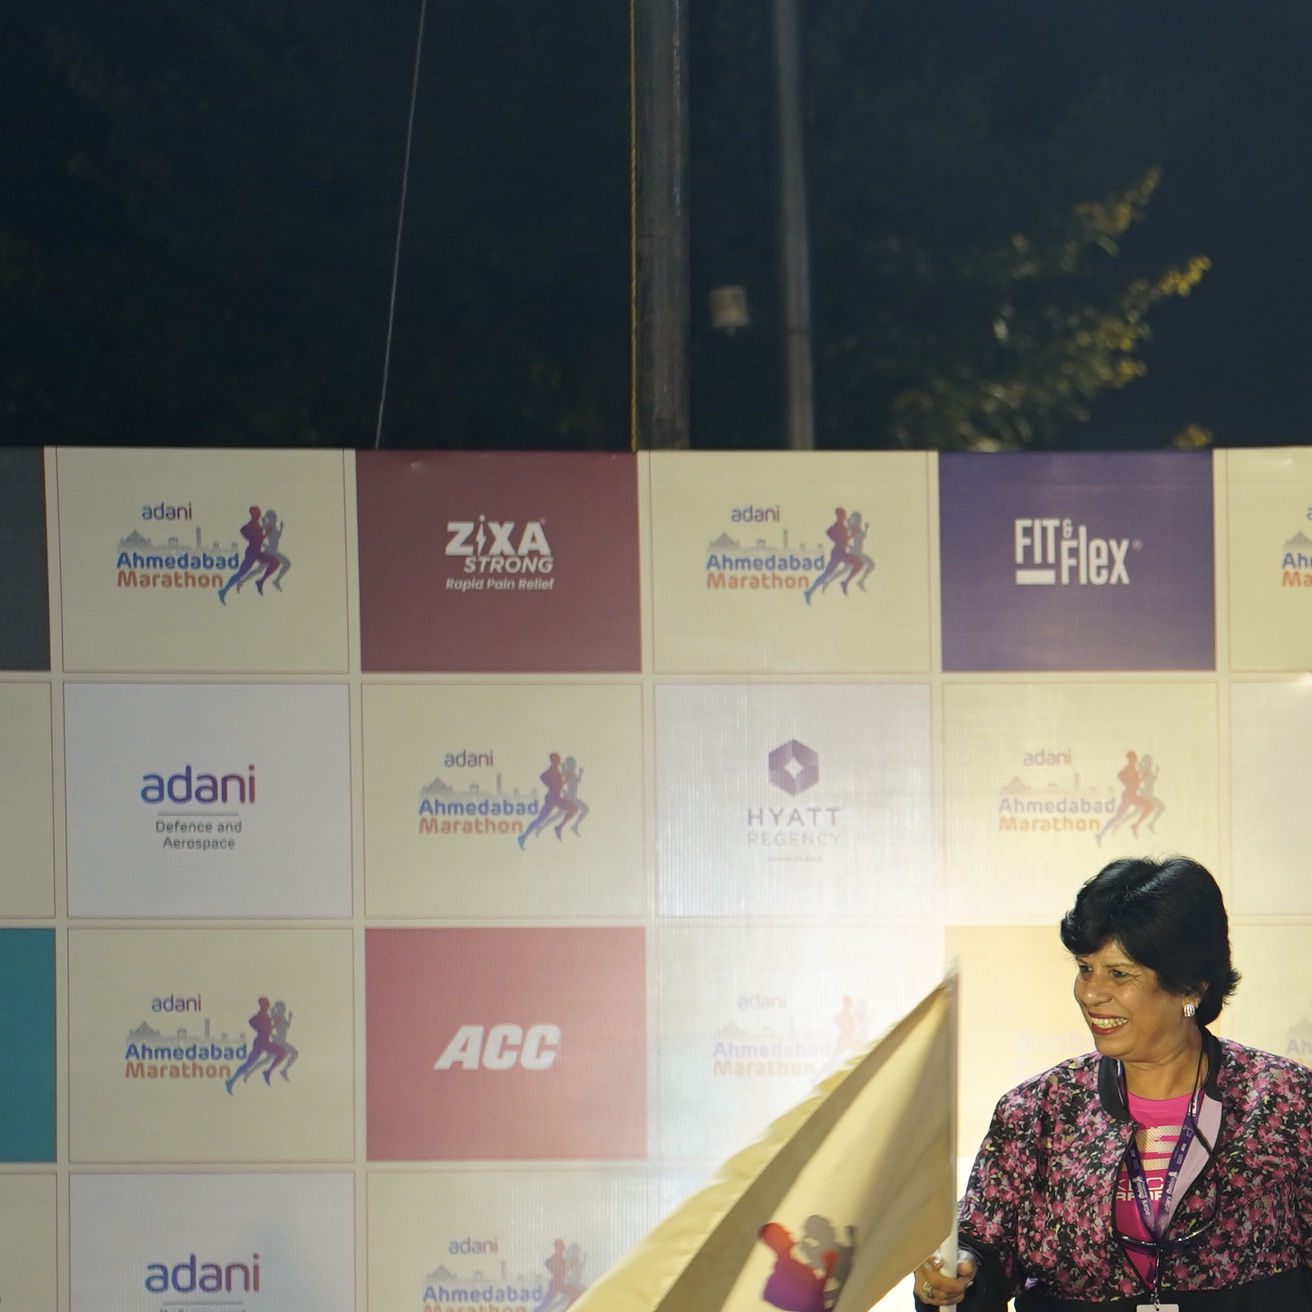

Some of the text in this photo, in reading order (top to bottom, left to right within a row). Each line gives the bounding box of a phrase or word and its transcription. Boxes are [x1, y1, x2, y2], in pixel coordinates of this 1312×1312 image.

[141, 502, 193, 521] adani
[731, 505, 781, 523] adani
[117, 551, 240, 570] Ahmedabad
[1015, 519, 1060, 566] FIT
[1060, 538, 1130, 586] Flex
[463, 556, 553, 573] STRONG
[706, 554, 825, 571] Ahmedabad
[117, 570, 224, 589] Marathon
[446, 578, 555, 593] Rapid Pain Relief
[706, 572, 809, 589] Marathon
[444, 750, 494, 768] adani
[1023, 749, 1072, 767] adani
[141, 765, 255, 804] adani
[419, 799, 539, 817] Ahmedabad
[999, 798, 1116, 815] Ahmedabad
[419, 817, 524, 835] Marathon
[748, 808, 840, 826] HYATT
[999, 815, 1101, 833] Marathon
[155, 820, 242, 833] Defence and
[162, 836, 236, 851] Aerospace
[748, 833, 840, 847] REGENCY
[151, 995, 202, 1013] adani
[125, 1043, 248, 1061] Ahmedabad
[434, 1024, 561, 1071] ACC
[712, 1042, 830, 1058] Ahmedabad
[125, 1061, 231, 1080] Marathon
[713, 1060, 814, 1076] Marathon
[449, 1237, 498, 1255] adani
[144, 1253, 261, 1293] adani
[423, 1286, 543, 1303] Ahmedabad
